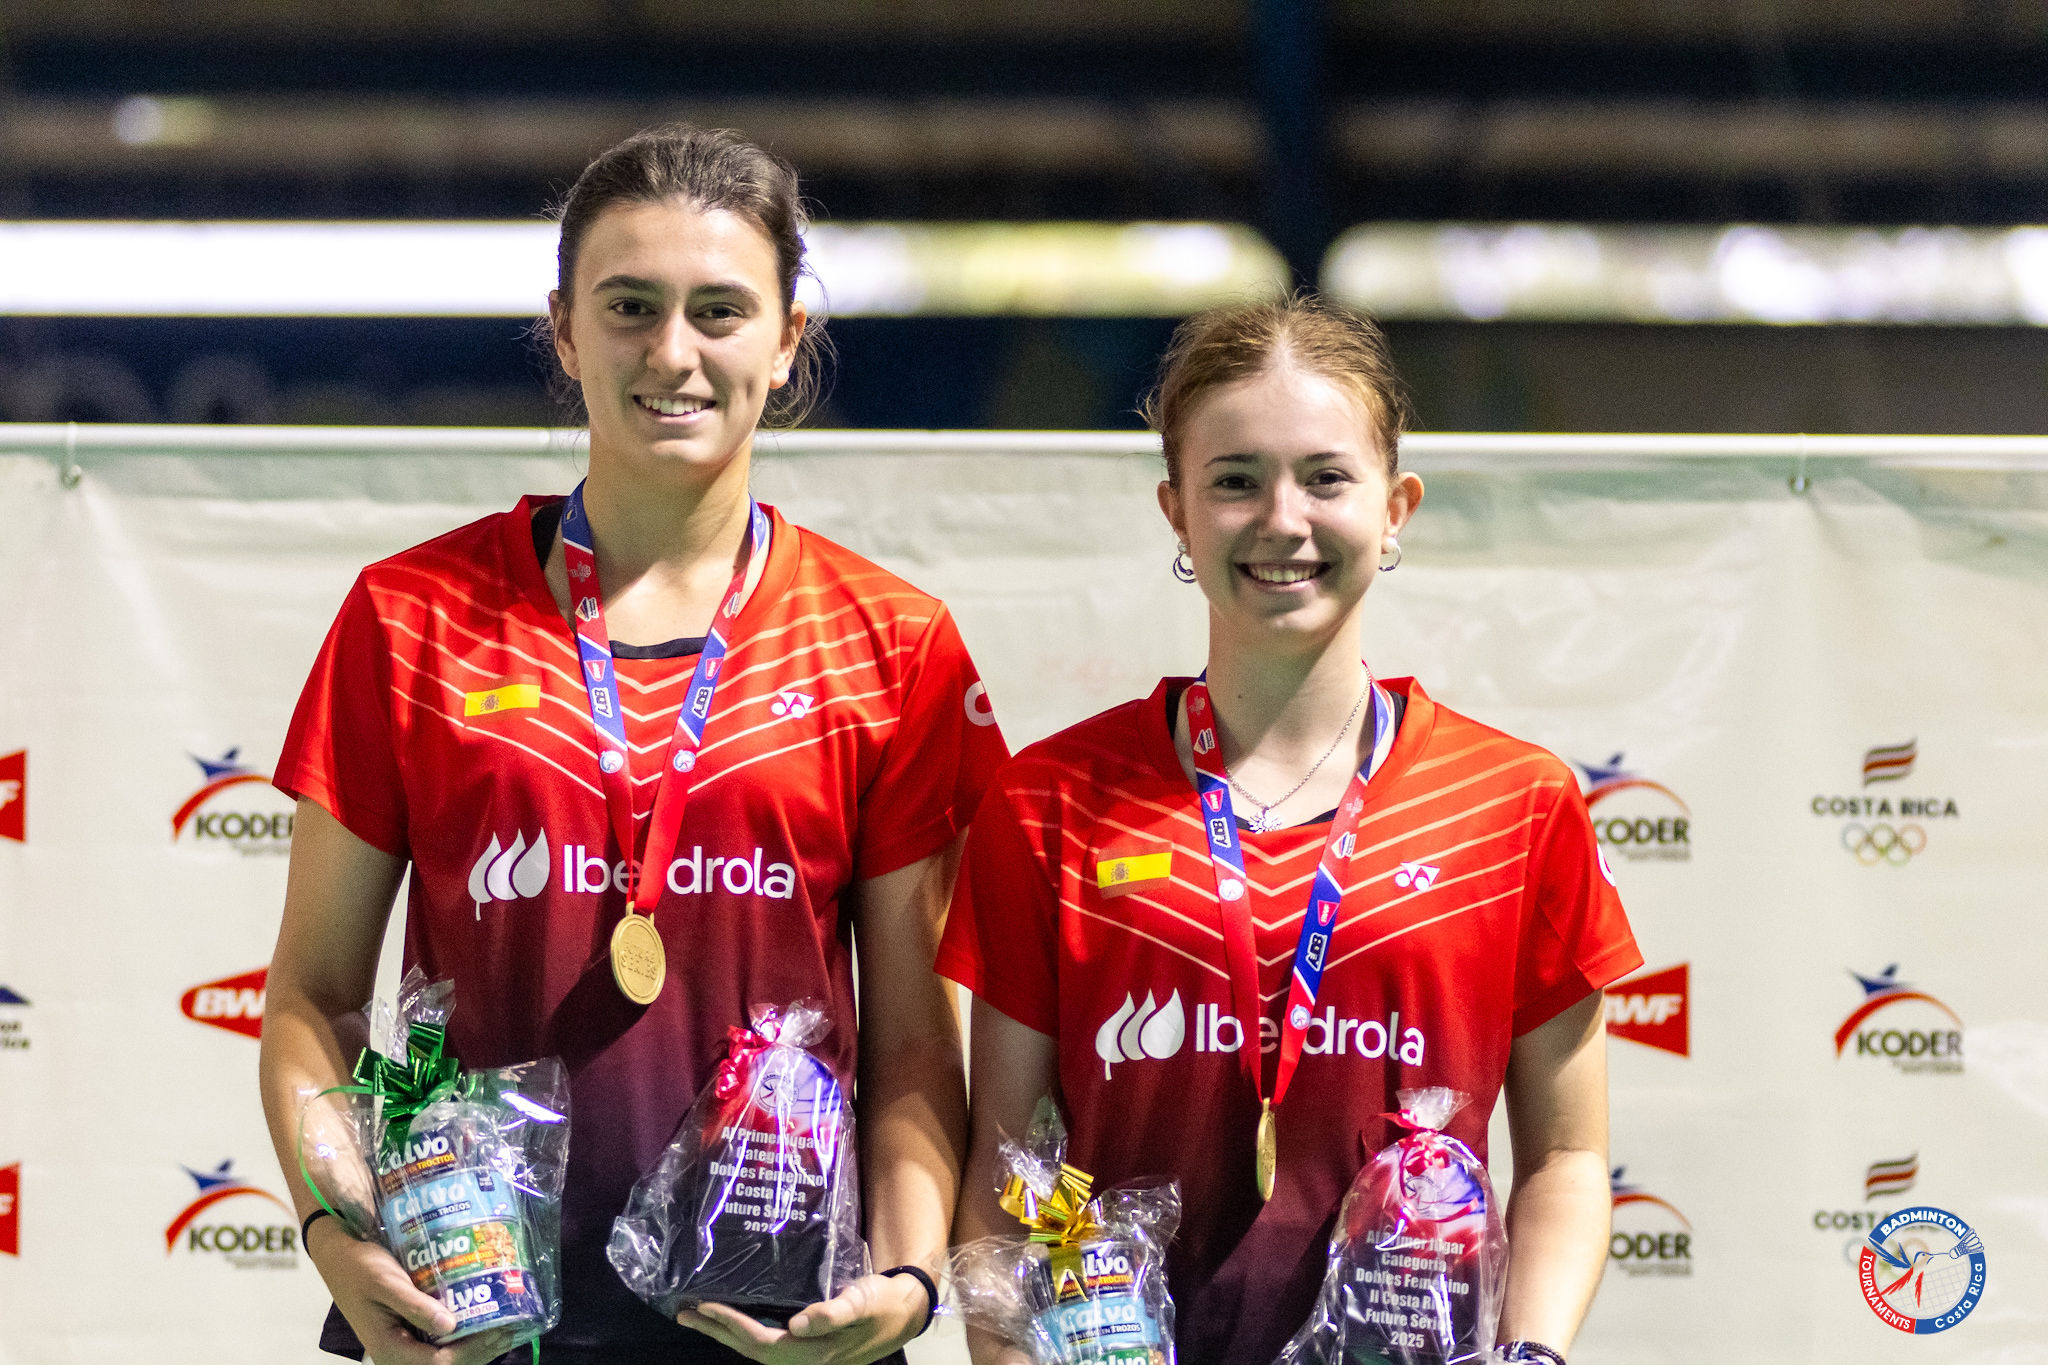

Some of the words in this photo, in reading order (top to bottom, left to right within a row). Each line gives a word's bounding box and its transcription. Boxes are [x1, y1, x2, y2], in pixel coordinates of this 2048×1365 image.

[1812, 796, 1892, 817] COSTA
[1901, 797, 1959, 818] RICA
[1593, 817, 1689, 844] CODER
[563, 844, 796, 900] Ibedrola
[193, 988, 266, 1018] BW
[1196, 1003, 1425, 1067] Ibedrola
[1858, 1029, 1962, 1057] ICODER
[785, 1133, 818, 1149] luga
[710, 1161, 756, 1179] Dobes
[393, 1183, 467, 1222] Calvo
[735, 1182, 774, 1200] Costa
[720, 1200, 761, 1217] uture
[763, 1204, 807, 1222] Sees
[1814, 1211, 1890, 1230] COST
[189, 1225, 297, 1252] ICODER
[1610, 1232, 1691, 1259] ODER
[407, 1235, 471, 1271] Calvo
[1085, 1253, 1129, 1277] lvo
[1404, 1273, 1470, 1295] Femino
[446, 1283, 492, 1312] lvo
[1382, 1290, 1420, 1309] Costa
[1365, 1308, 1408, 1328] Future
[1410, 1313, 1452, 1332] Seri
[1390, 1331, 1425, 1348] 2025
